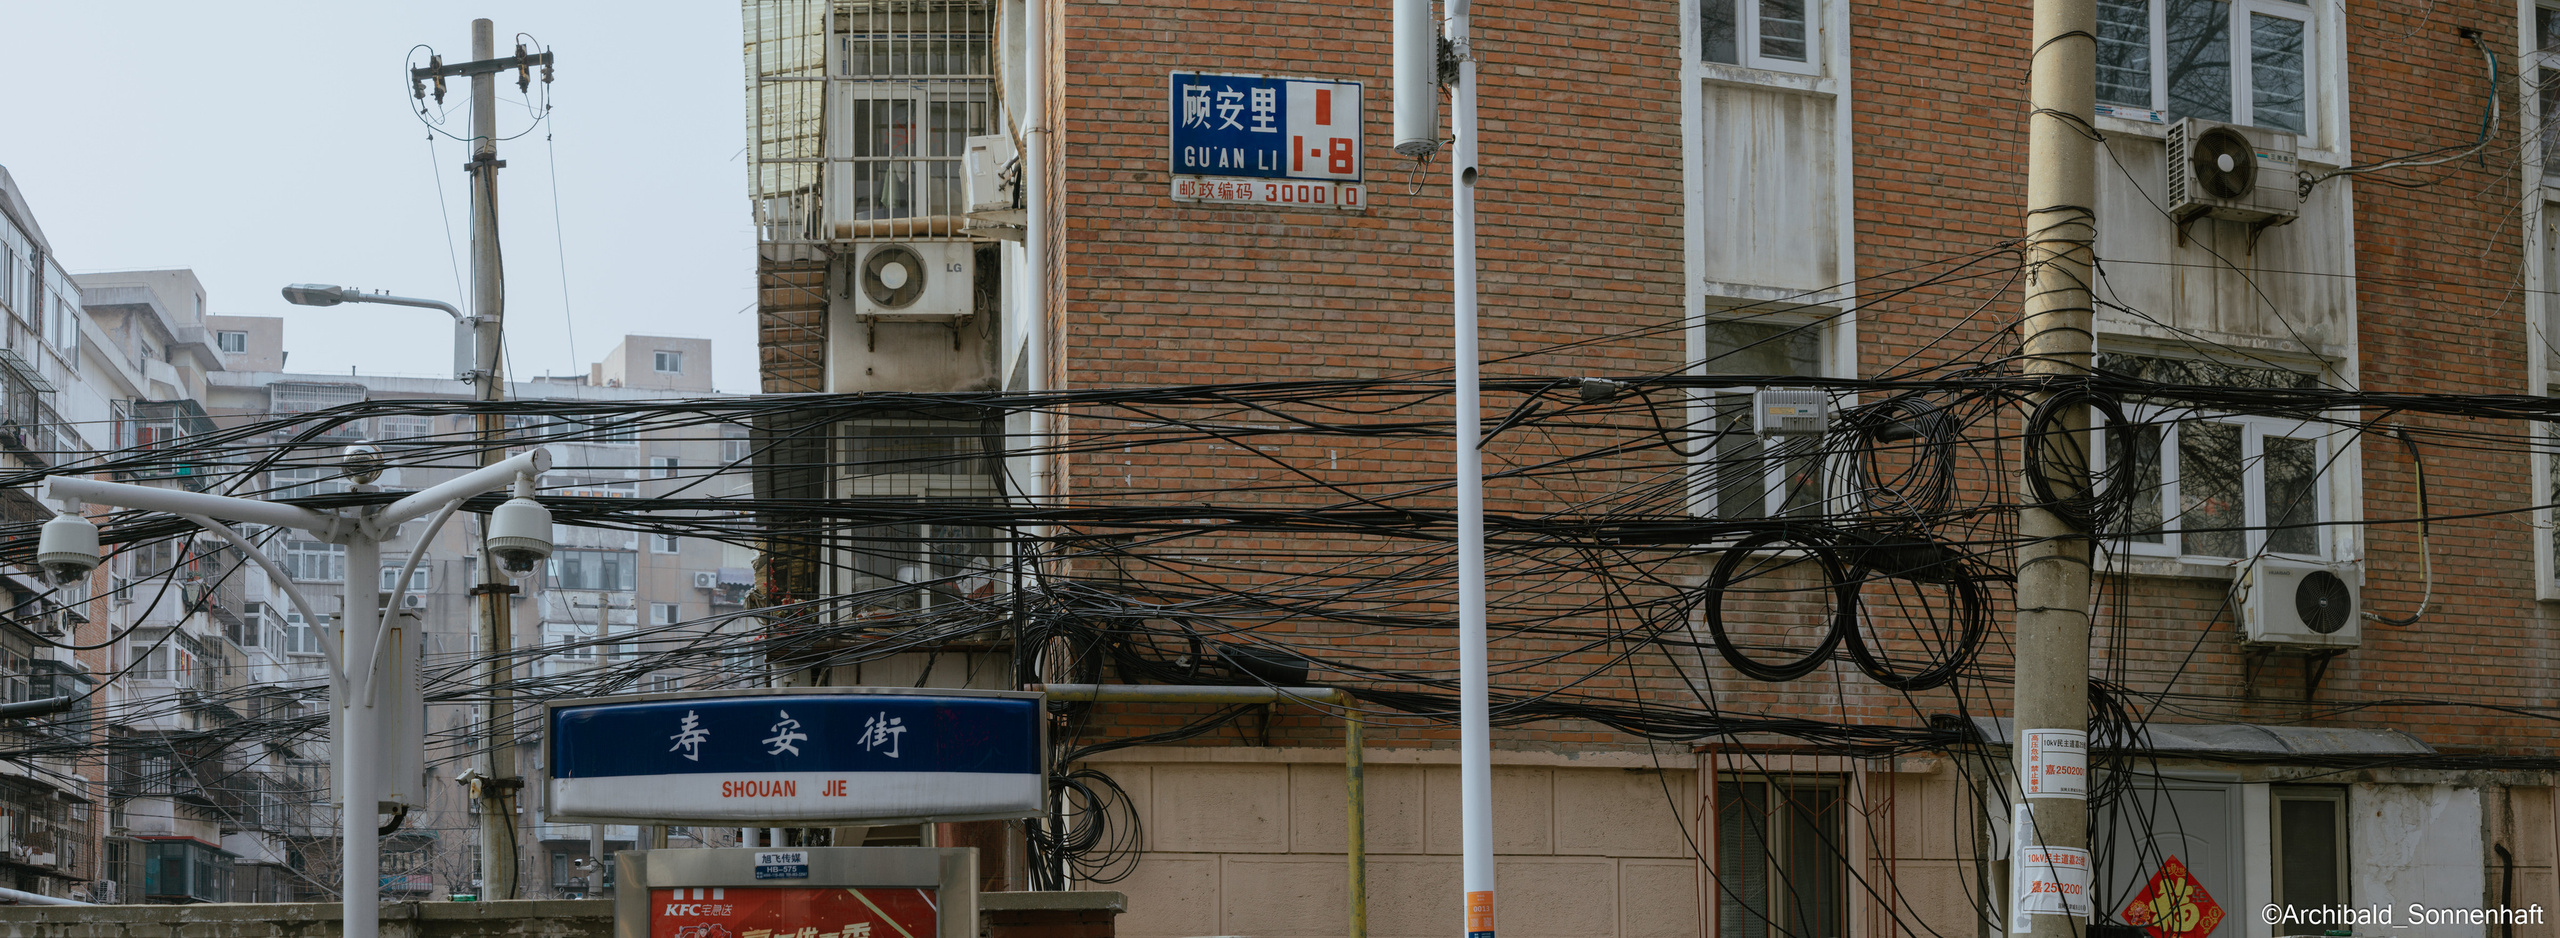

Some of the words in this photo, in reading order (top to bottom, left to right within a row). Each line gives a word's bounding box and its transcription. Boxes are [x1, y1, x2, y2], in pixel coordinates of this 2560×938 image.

[1182, 84, 1278, 133] 顾安里
[1258, 149, 1277, 171] LI
[1293, 135, 1354, 174] 1-8
[1179, 181, 1253, 200] 邮政编码
[1265, 183, 1357, 206] 300010
[946, 263, 962, 272] LG
[668, 709, 907, 762] 寿安街
[2030, 734, 2039, 762] 高压危险
[721, 780, 796, 798] SHOUAN
[822, 779, 847, 798] JIE
[2030, 765, 2039, 793] 禁止攀登
[761, 852, 802, 864] 旭飞传媒
[766, 865, 797, 873] HB-575
[664, 903, 701, 917] KFC
[700, 903, 733, 917] 宅急送
[1473, 905, 1490, 913] 0013
[2149, 877, 2200, 932] 福
